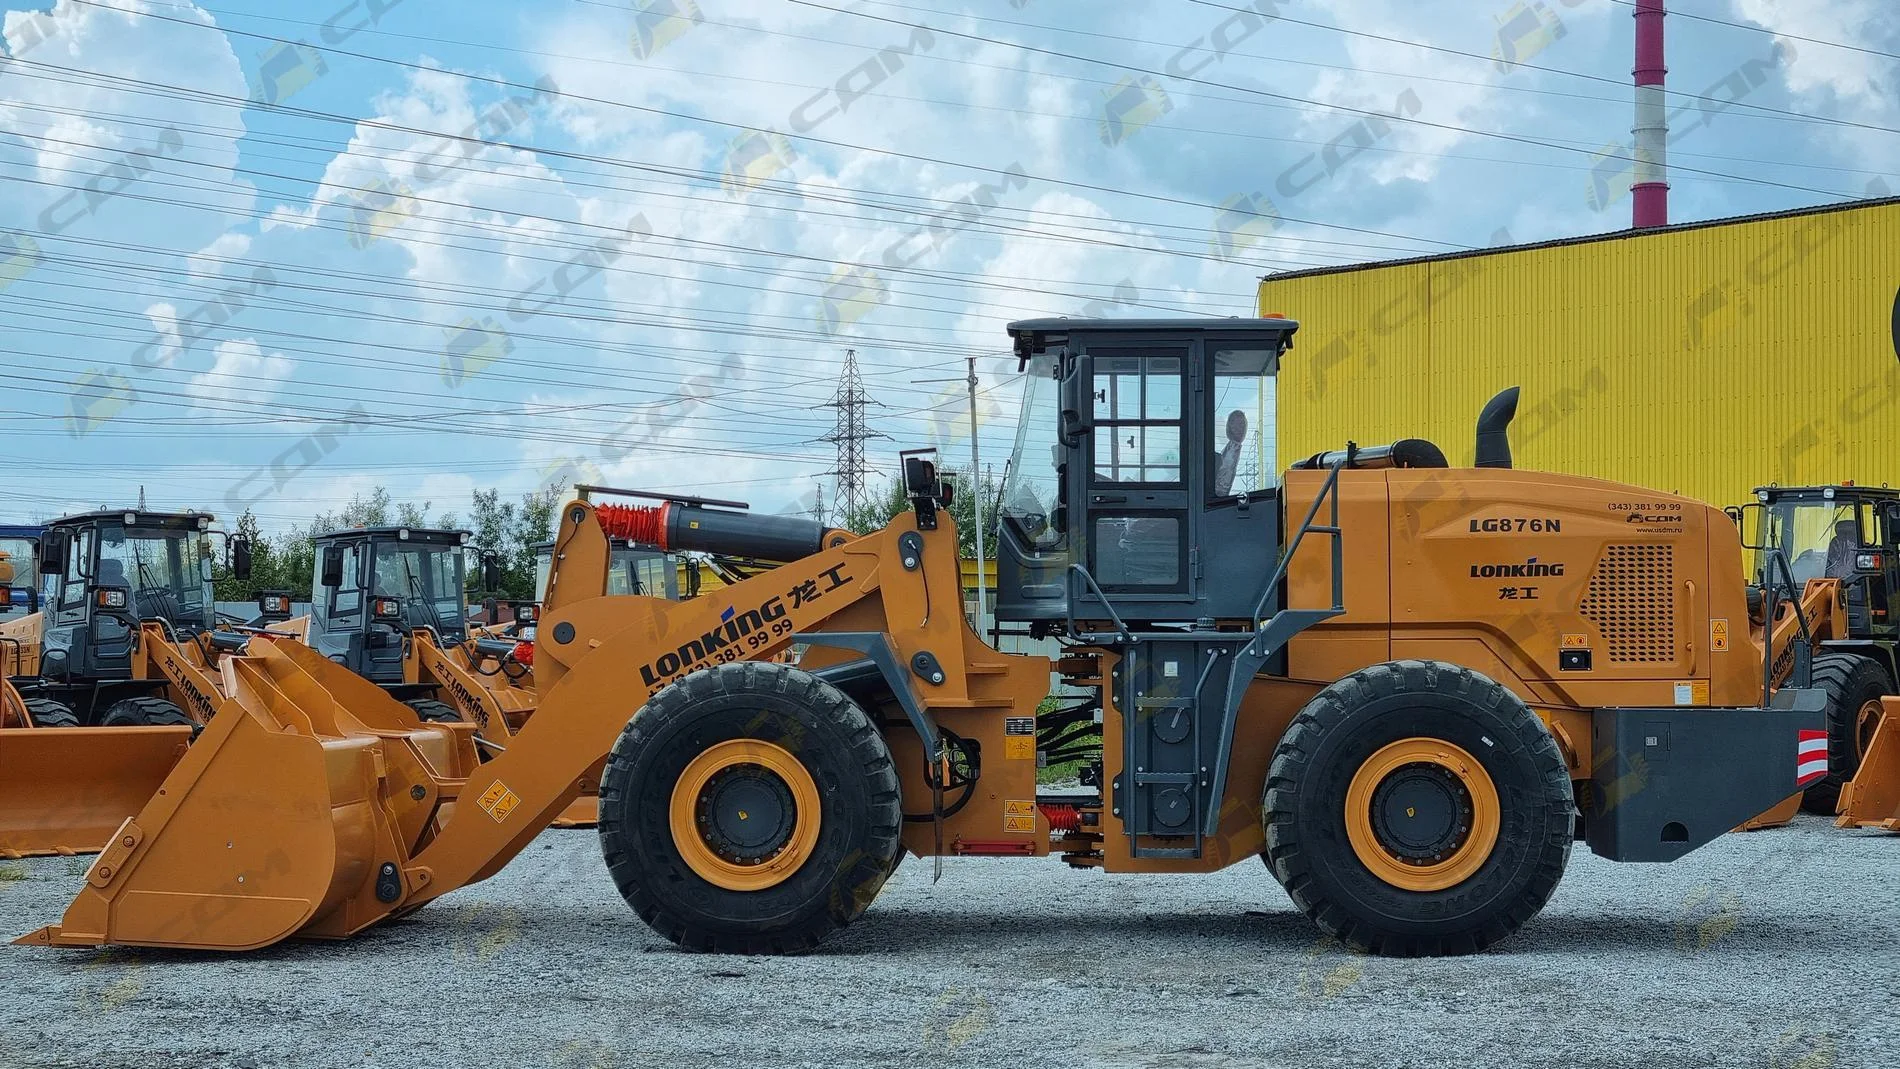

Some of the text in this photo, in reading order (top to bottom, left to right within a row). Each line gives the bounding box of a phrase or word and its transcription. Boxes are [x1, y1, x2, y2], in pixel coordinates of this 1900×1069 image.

[1607, 503, 1681, 511] (343) 381 99 99
[1469, 518, 1561, 533] LG876N
[714, 644, 746, 665] 381
[747, 631, 769, 650] 99
[771, 618, 793, 638] 99
